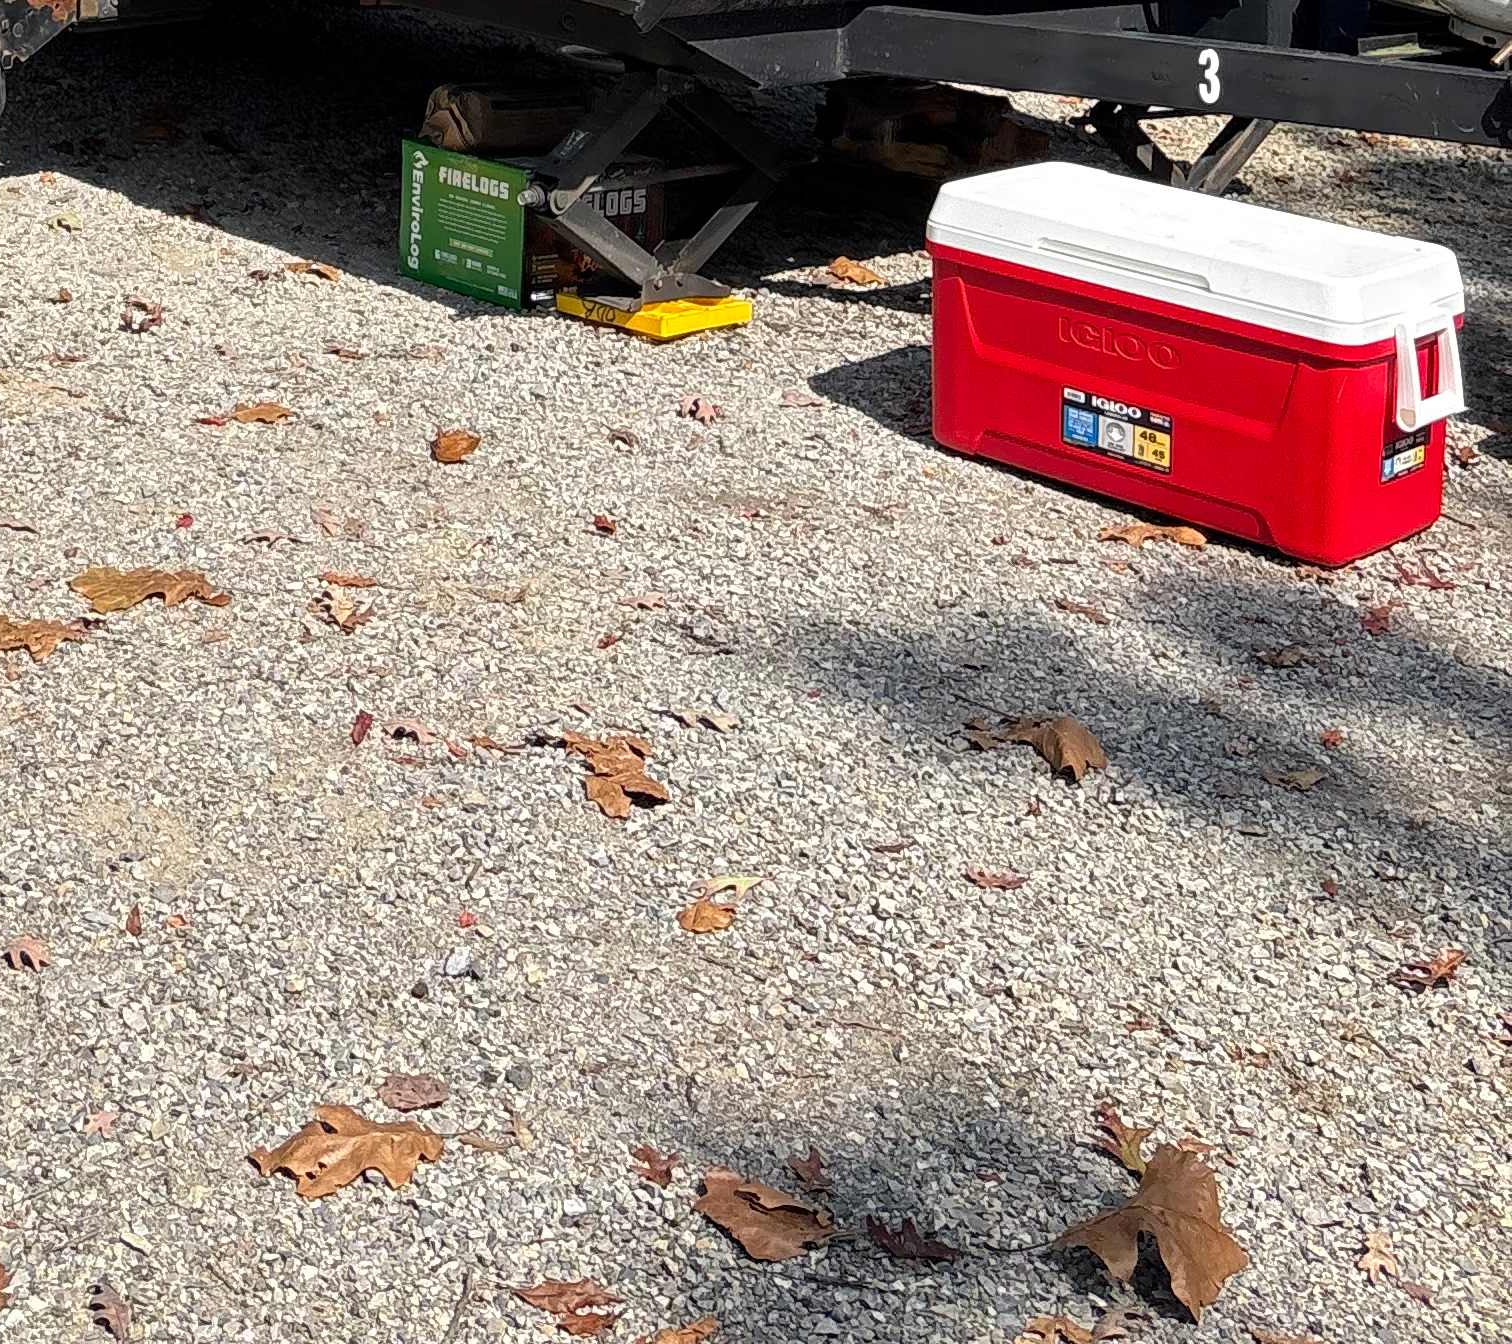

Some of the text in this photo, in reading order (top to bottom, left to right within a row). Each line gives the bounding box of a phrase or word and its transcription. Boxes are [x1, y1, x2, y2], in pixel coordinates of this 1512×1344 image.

[1198, 48, 1221, 104] 3
[438, 166, 510, 200] FIRELOGS
[1058, 316, 1181, 370] IGLOO
[1091, 395, 1142, 419] IGLOO
